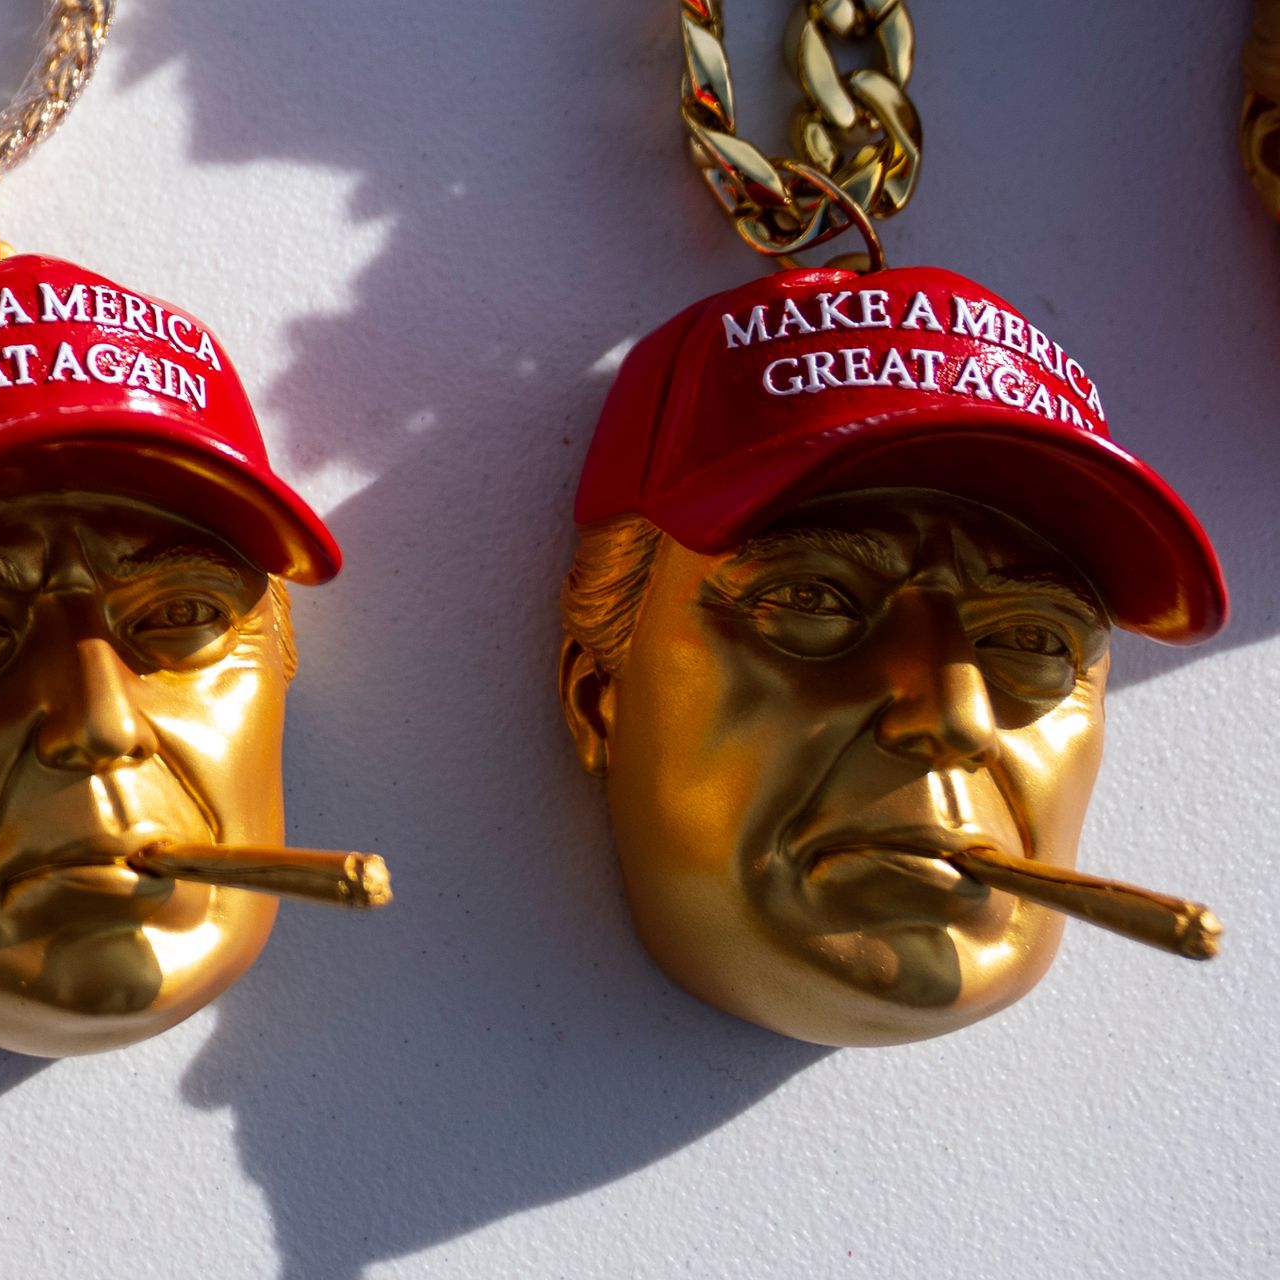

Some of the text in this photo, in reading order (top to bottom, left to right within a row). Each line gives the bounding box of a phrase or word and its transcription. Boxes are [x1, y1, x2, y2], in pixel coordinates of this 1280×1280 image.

[721, 290, 890, 348] MAKE
[48, 341, 206, 409] AGAIN
[762, 348, 945, 396] GREAT
